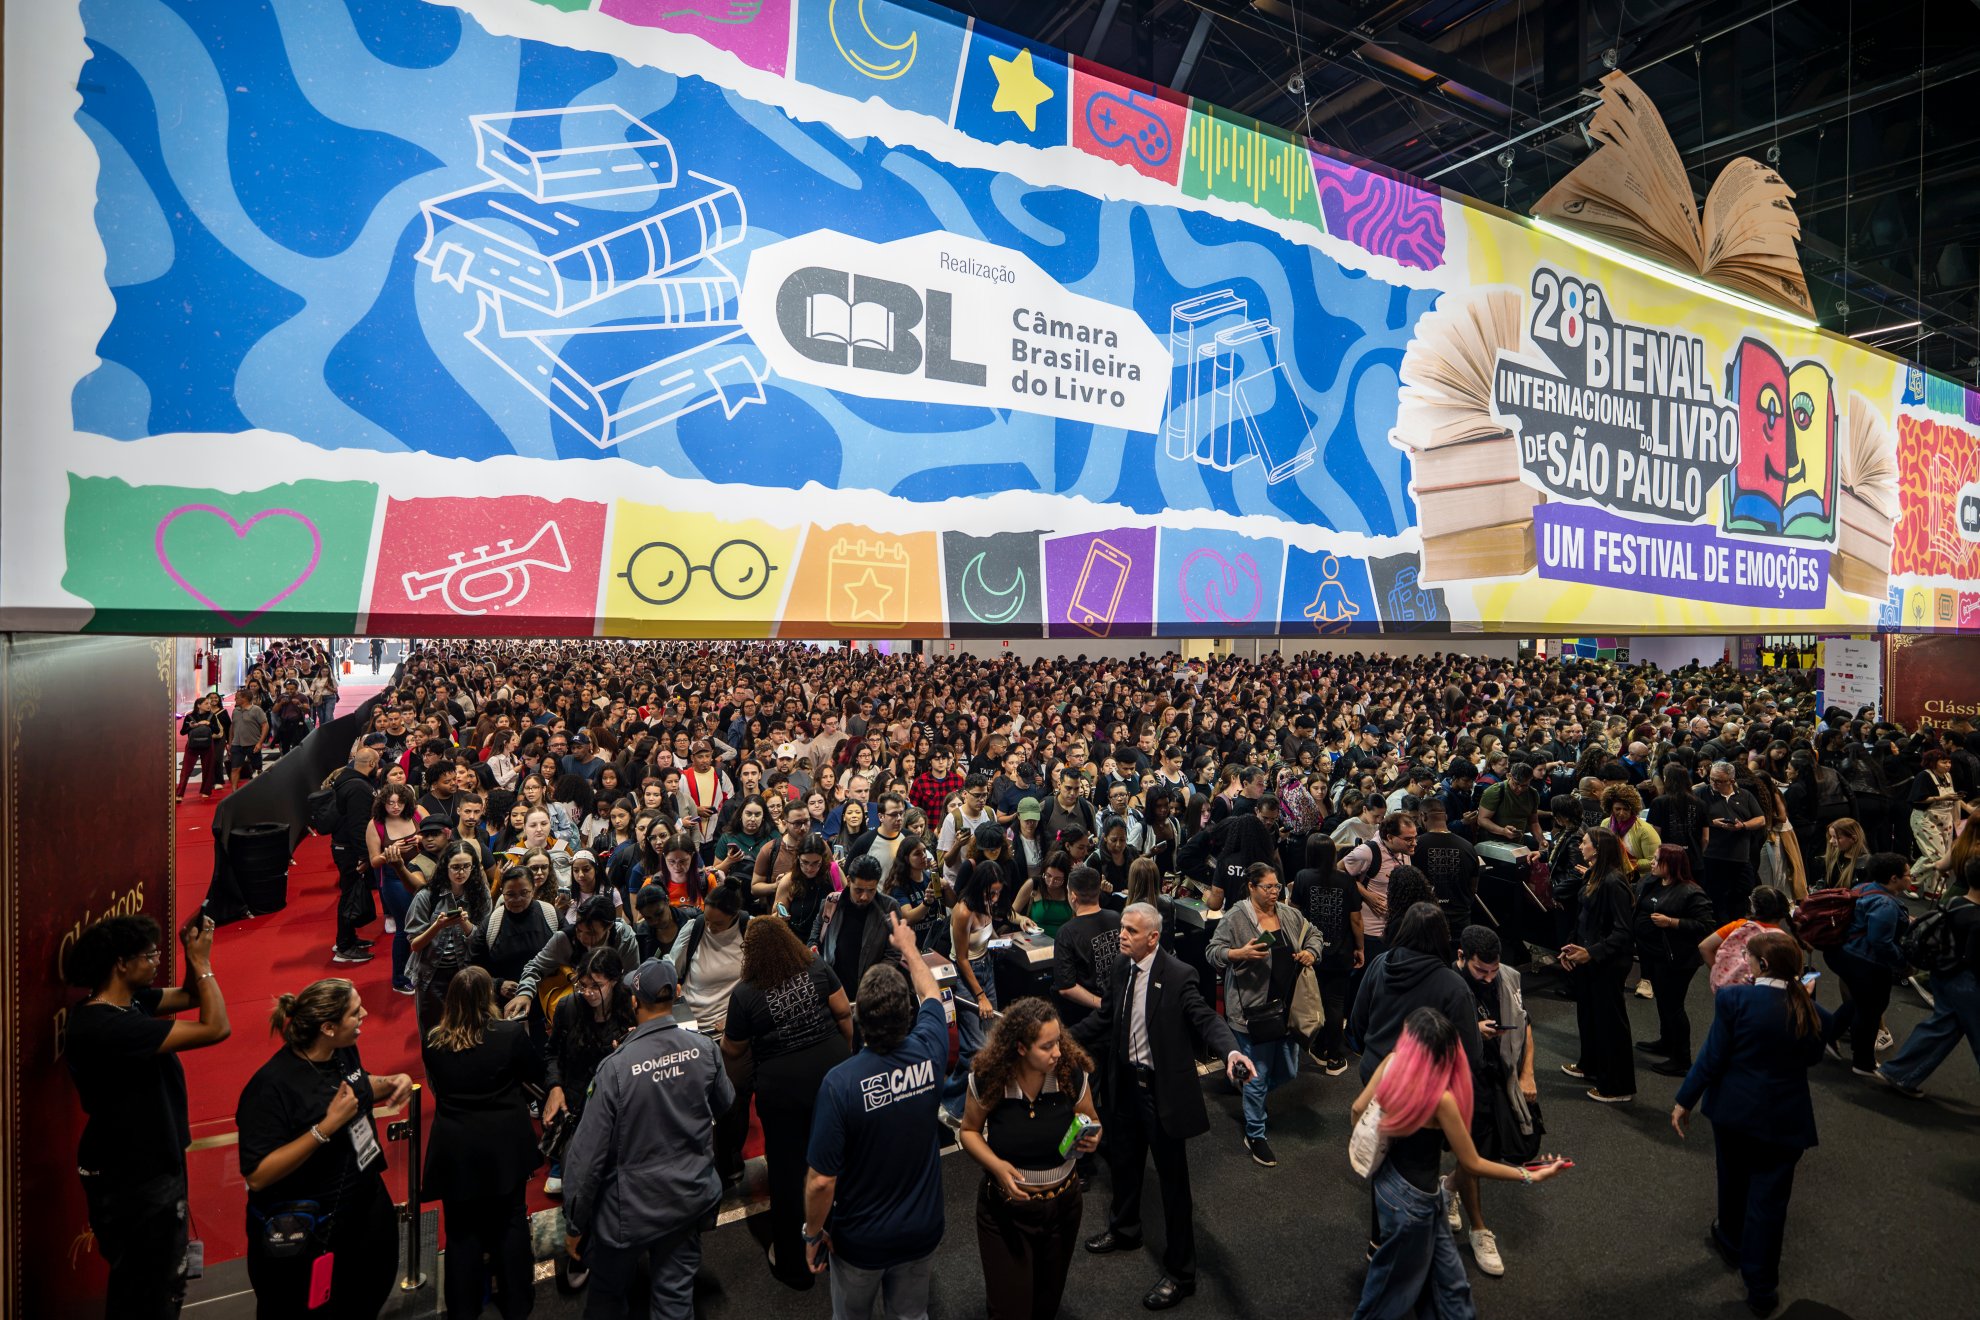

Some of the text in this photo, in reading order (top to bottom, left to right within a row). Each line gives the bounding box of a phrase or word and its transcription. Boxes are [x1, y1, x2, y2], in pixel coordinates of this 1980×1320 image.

[940, 251, 1016, 284] Realização
[776, 266, 987, 388] CBL
[1012, 307, 1118, 349] Câmara
[1012, 338, 1141, 382] Brasileira
[1586, 322, 1711, 402] BIENAL
[1011, 369, 1125, 408] do Livro
[1499, 369, 1738, 465] INTERNACIONAL DO LIVRO
[1525, 426, 1701, 515] DE SÃO PAULO
[1543, 522, 1819, 599] UM FESTIVAL DE EMOÇÕES
[769, 982, 815, 1015] STAFF
[631, 1047, 700, 1076] BOMBEIRO
[652, 1065, 685, 1083] CIVIL
[891, 1059, 935, 1095] CAVA
